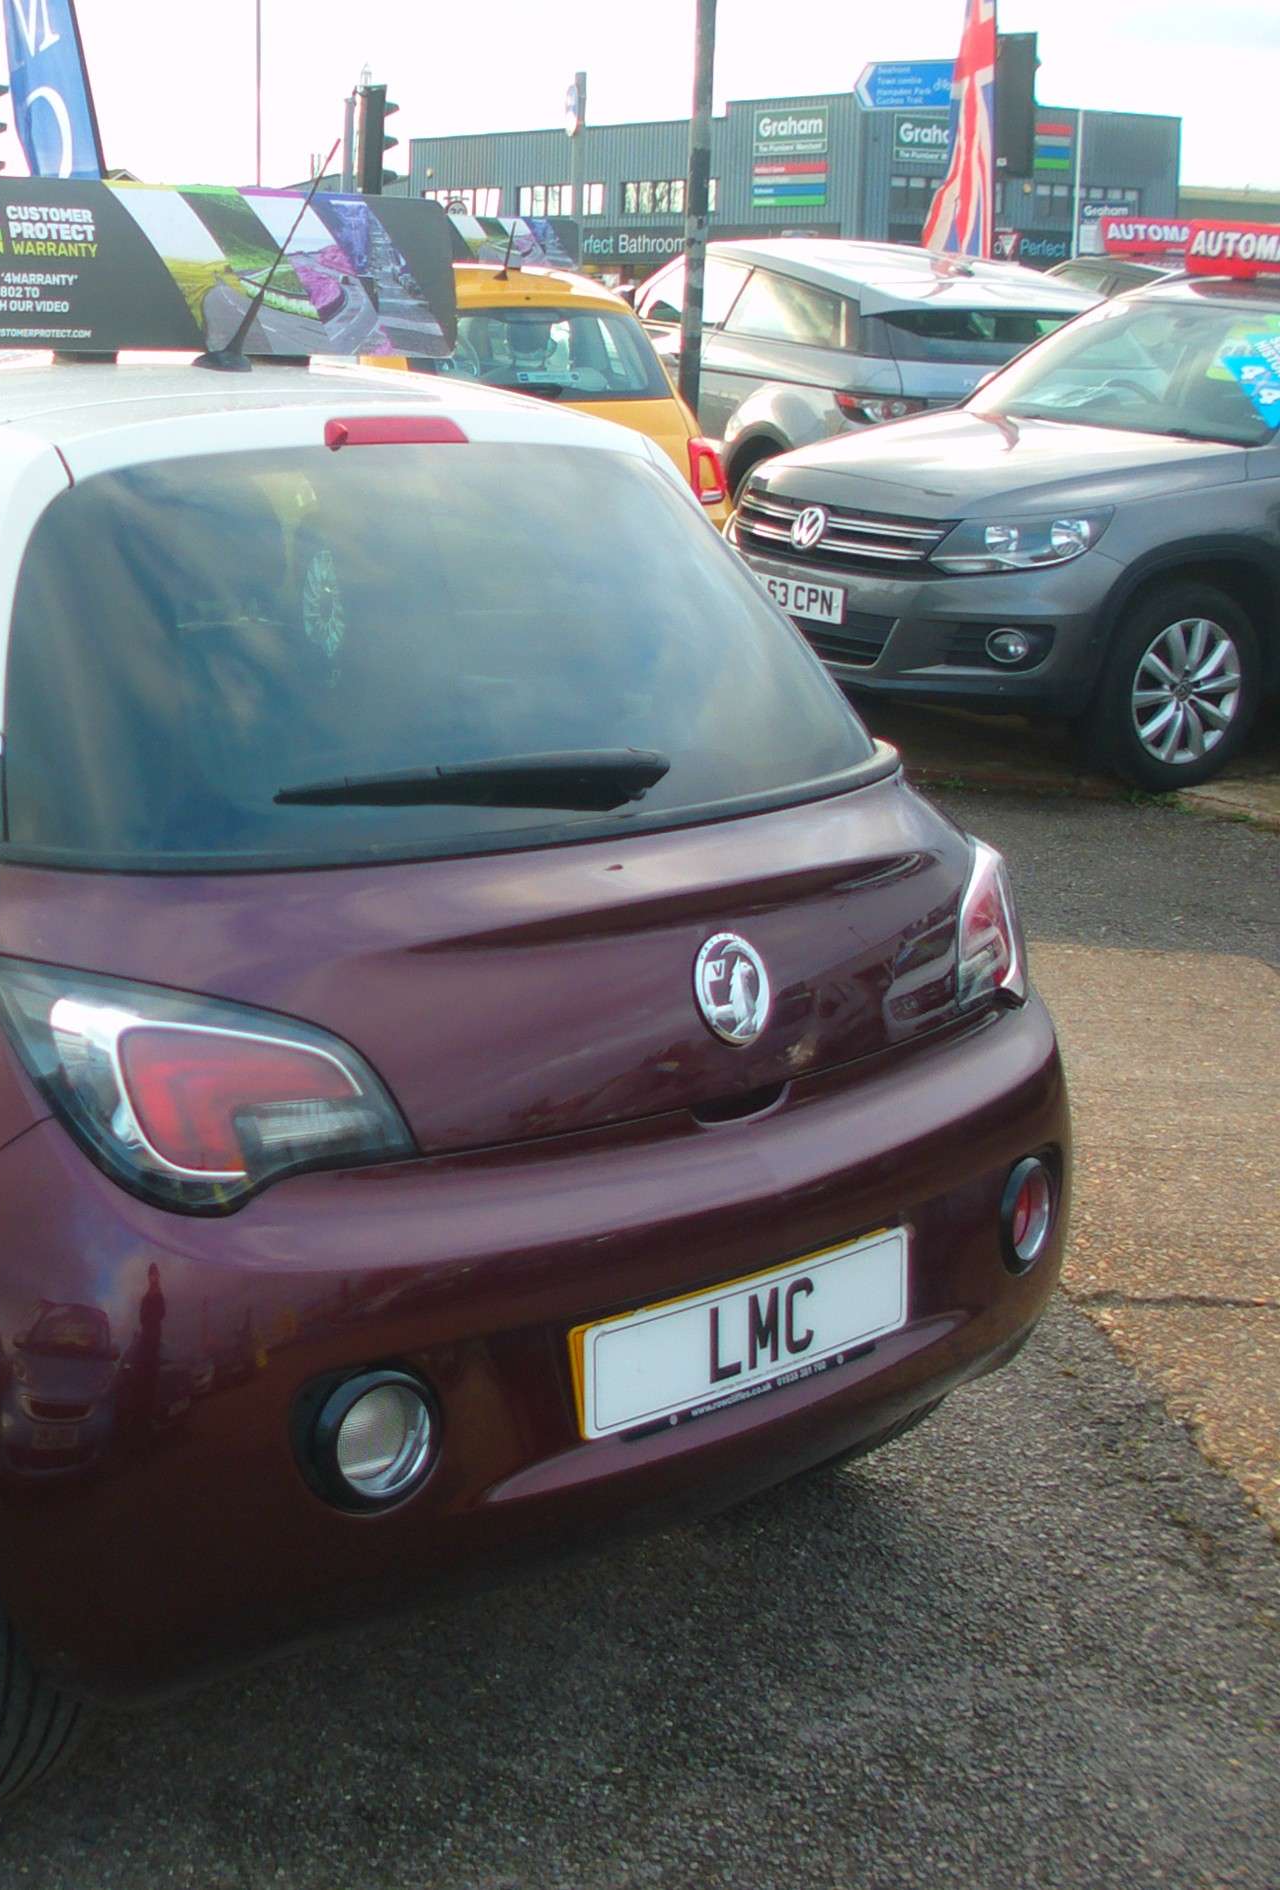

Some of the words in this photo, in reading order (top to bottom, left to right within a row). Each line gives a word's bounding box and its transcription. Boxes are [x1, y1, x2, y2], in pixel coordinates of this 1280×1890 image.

[759, 116, 823, 138] Graham
[6, 205, 94, 223] CUSTOMER
[8, 221, 96, 241] PROTECT
[12, 240, 98, 257] WARRANTY
[583, 233, 613, 254] rfect
[618, 233, 686, 254] Bathroom
[1020, 238, 1066, 257] Perfect
[24, 286, 40, 298] TO
[9, 300, 34, 312] OUR
[35, 300, 70, 313] VIDEO
[794, 586, 834, 616] CPN
[709, 1276, 815, 1385] LMC
